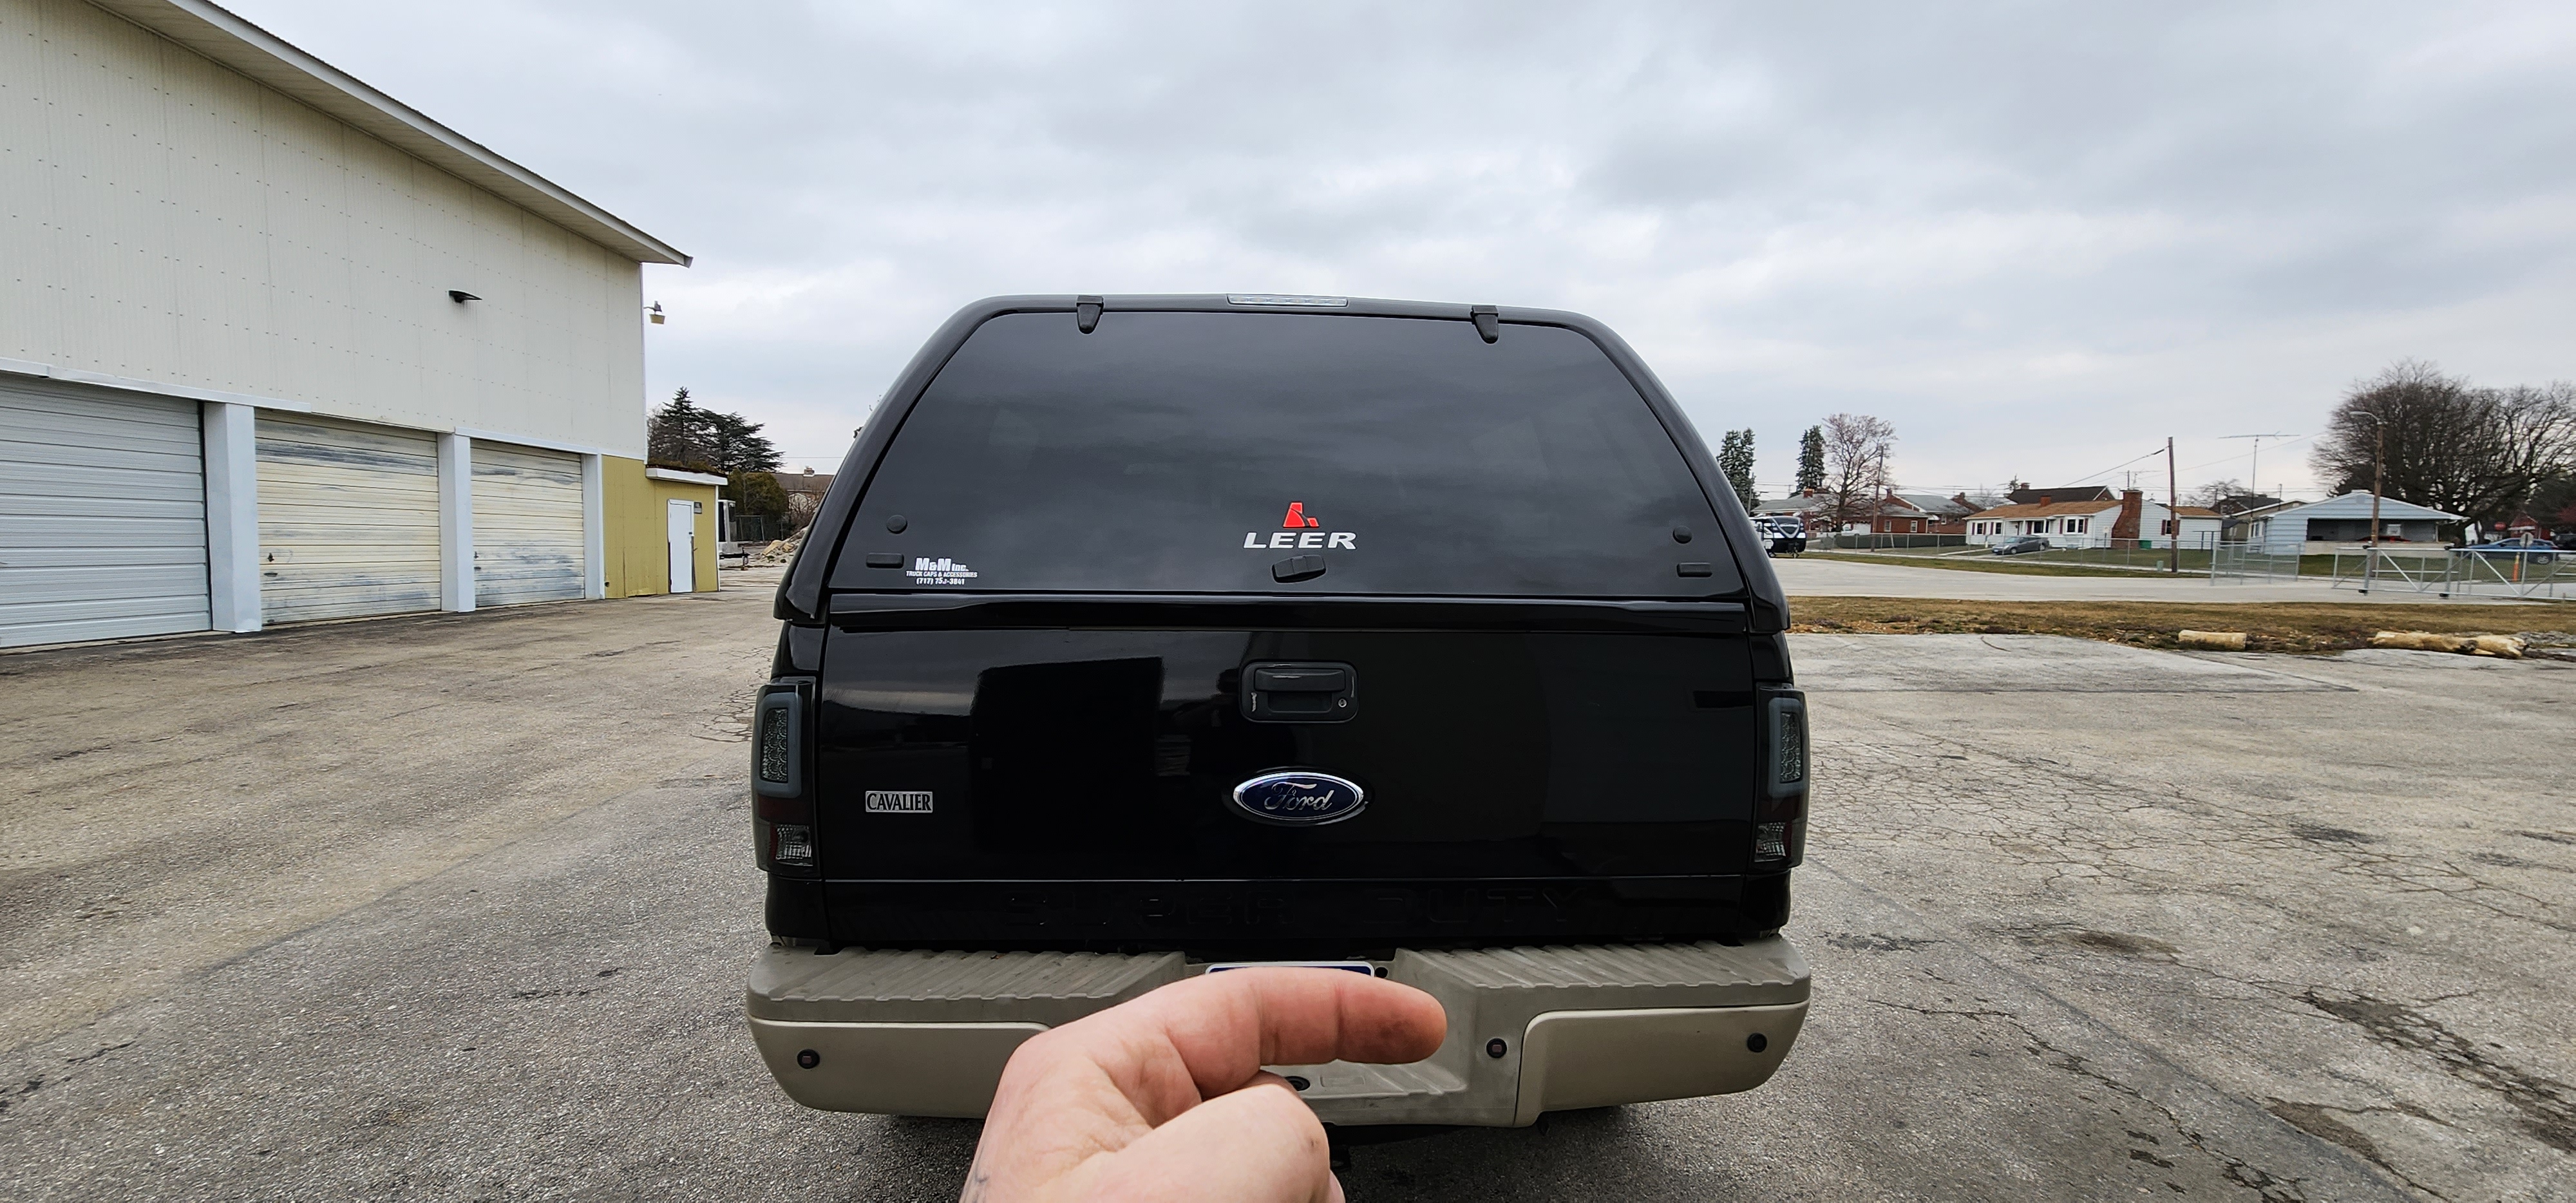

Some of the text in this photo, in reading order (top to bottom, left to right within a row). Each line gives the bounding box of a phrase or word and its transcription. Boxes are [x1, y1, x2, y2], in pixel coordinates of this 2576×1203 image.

[1243, 532, 1357, 550] LEER
[915, 558, 969, 571] M&M Inc.
[866, 793, 932, 811] CAVALIER
[1264, 781, 1335, 811] Ford
[999, 887, 1587, 927] SUPER DUTY
